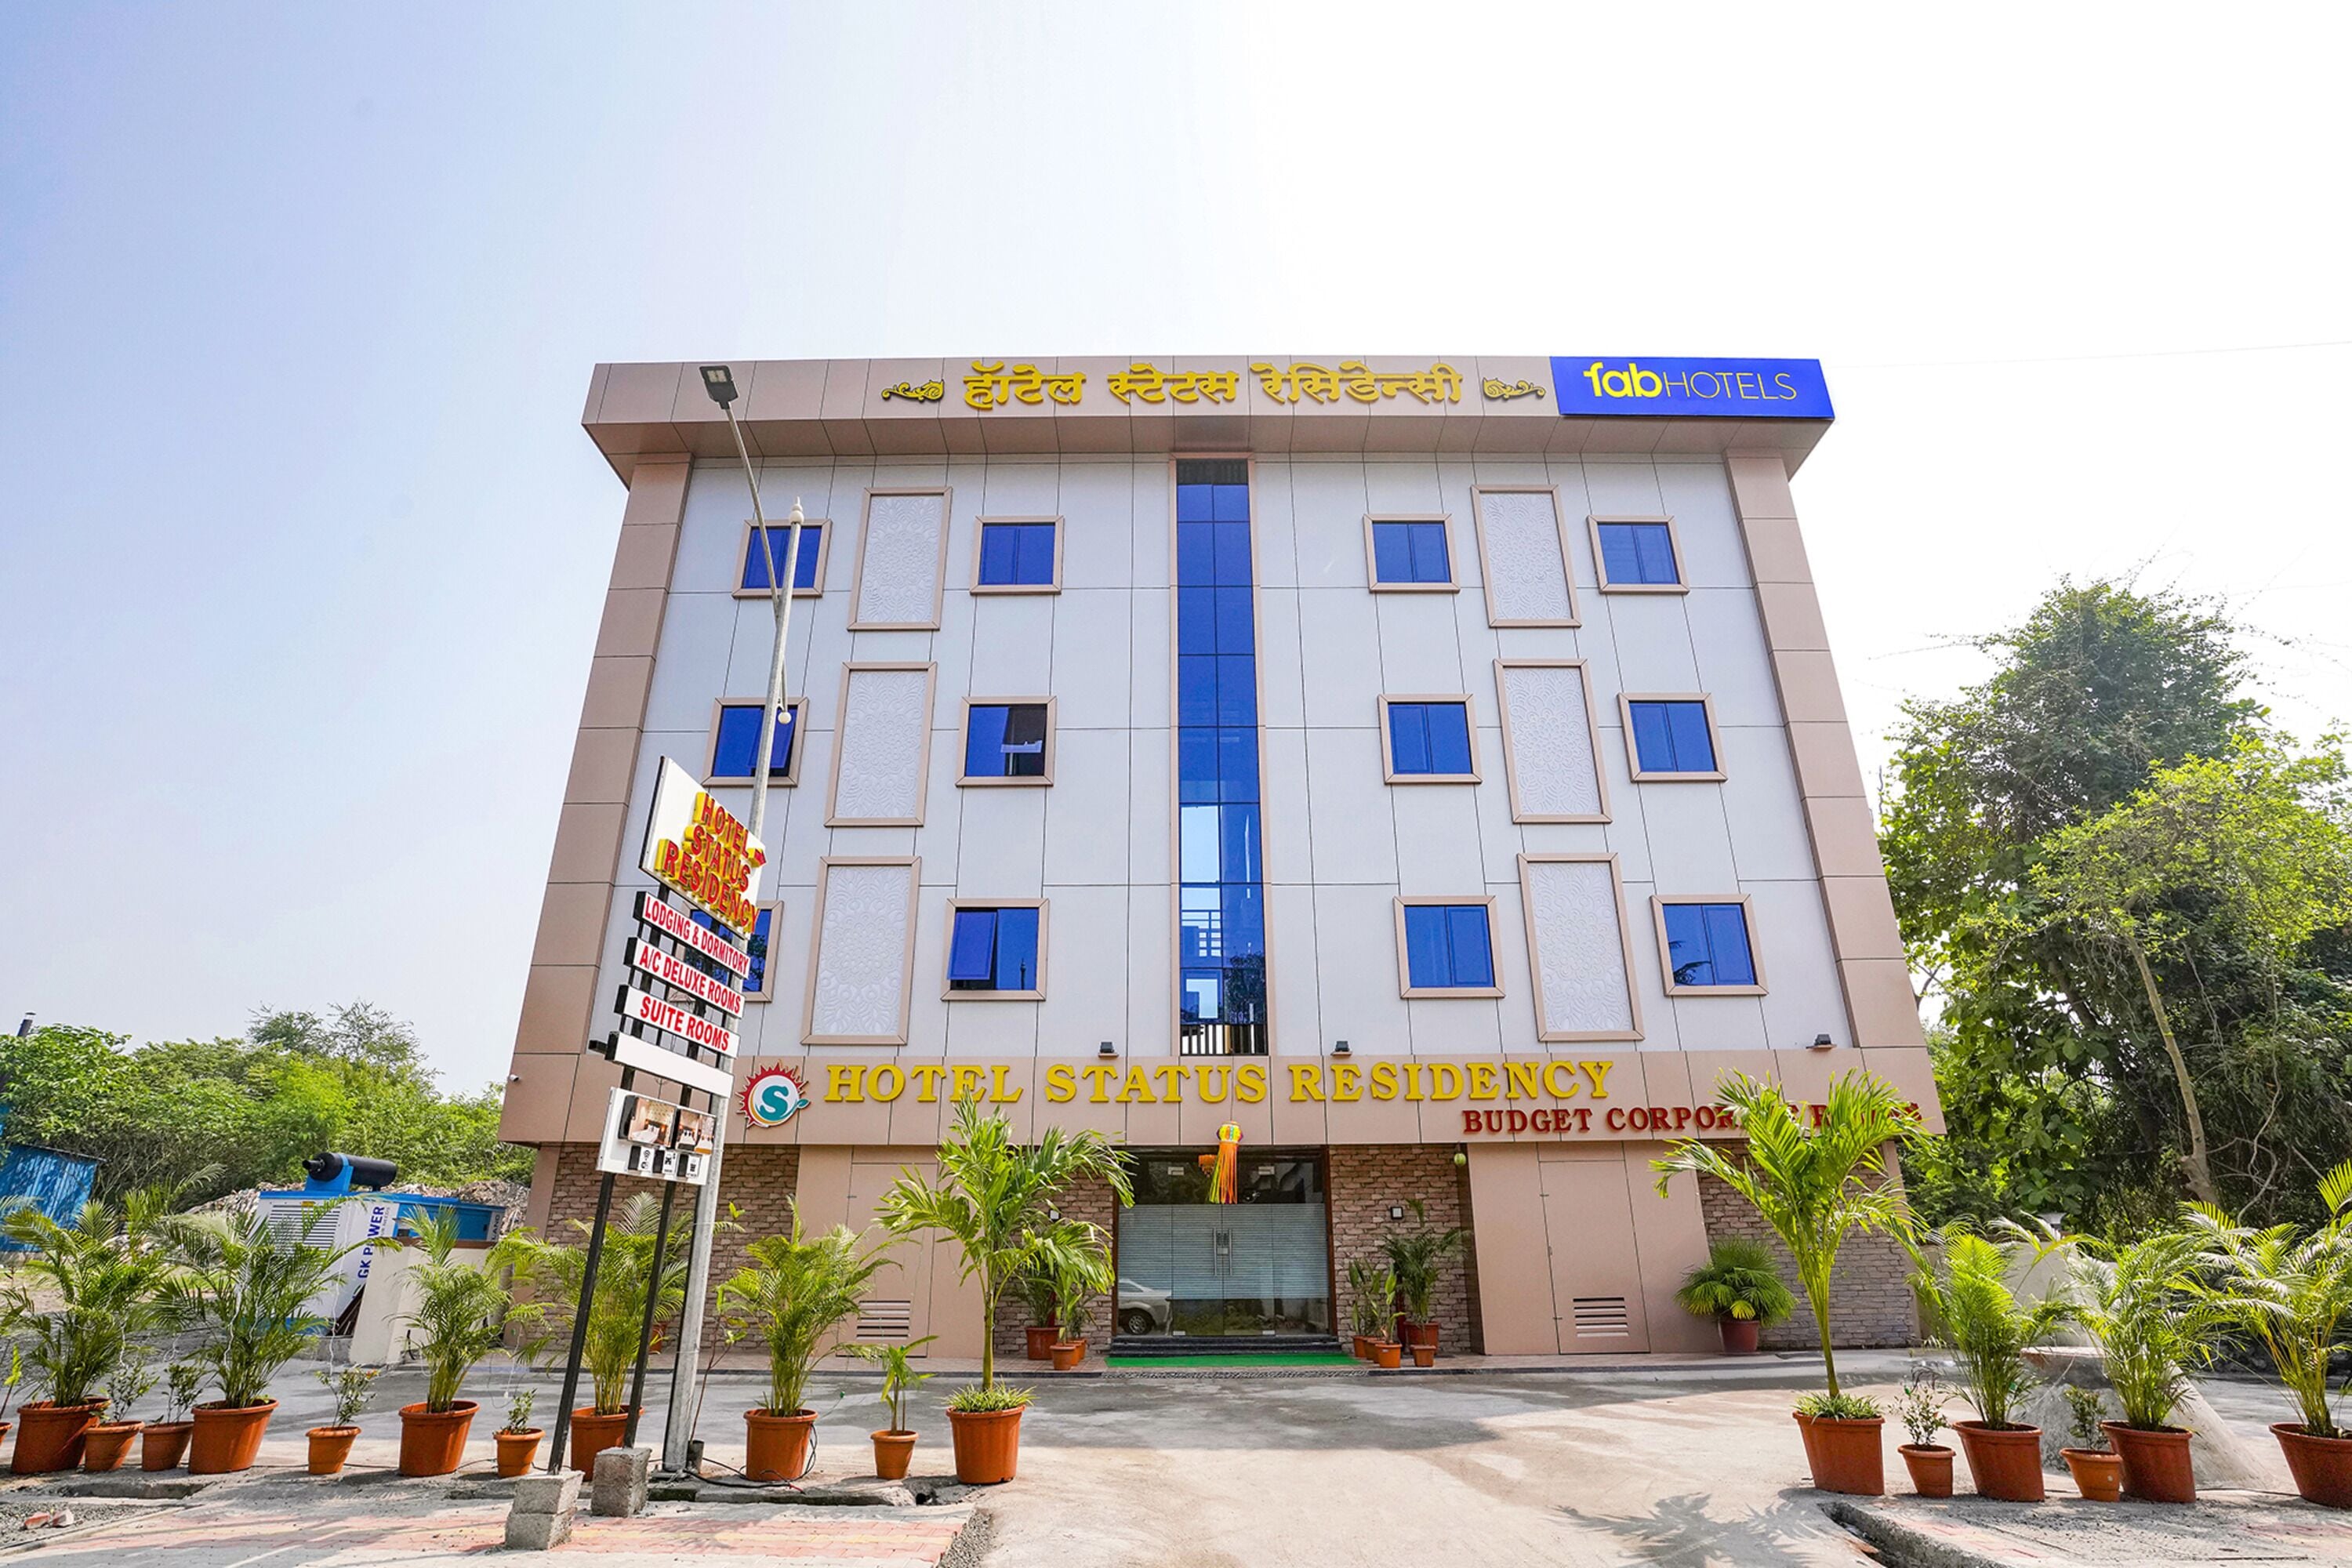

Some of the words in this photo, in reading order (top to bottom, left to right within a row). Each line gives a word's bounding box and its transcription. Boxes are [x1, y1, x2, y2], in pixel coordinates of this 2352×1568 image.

[963, 360, 1087, 410] हॉटेल
[1107, 362, 1240, 405] स्टेटस
[1250, 361, 1463, 404] रेसिडेन्सी
[1583, 361, 1797, 401] fabHOTELS
[697, 792, 750, 859] HOTEL
[687, 825, 751, 893] STATUS
[658, 839, 760, 935] RESIDENCY
[644, 895, 691, 940] LODGING
[692, 925, 699, 946] &
[700, 930, 750, 977] DORMITORY
[639, 945, 662, 973] A/C
[662, 956, 706, 996] DELUXE
[707, 980, 742, 1014] ROOMS
[640, 996, 685, 1033] SUITE
[685, 1017, 730, 1051] ROOMS
[823, 1063, 1024, 1103] HOTEL
[1044, 1063, 1268, 1104] STATUS
[1287, 1060, 1614, 1102] RESIDENCY
[1462, 1109, 1593, 1134] BUDGET
[1606, 1104, 1802, 1132] CORPOR
[357, 1260, 372, 1279] GK
